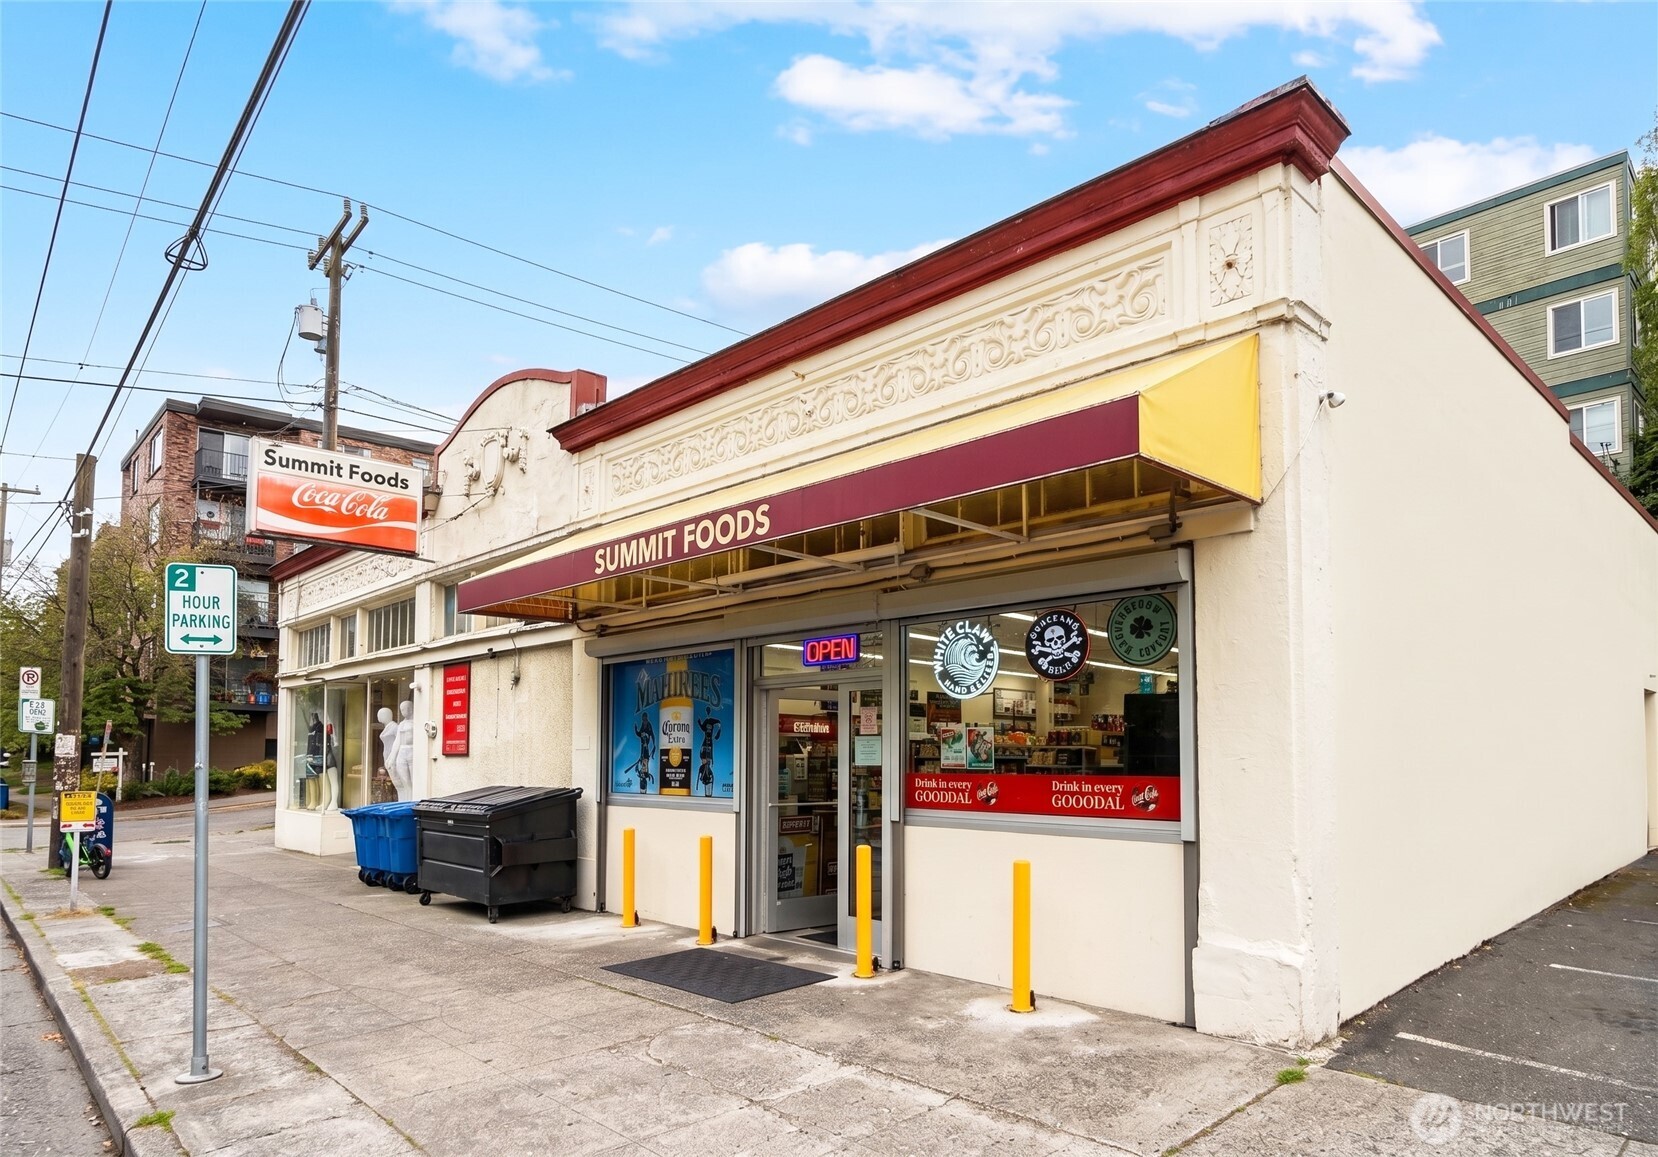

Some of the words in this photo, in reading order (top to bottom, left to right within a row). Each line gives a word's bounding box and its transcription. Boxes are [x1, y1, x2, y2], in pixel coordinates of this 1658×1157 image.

[264, 448, 343, 478] Summit
[349, 463, 409, 490] Foods
[594, 528, 677, 575] SUMMIT
[683, 503, 771, 554] FOODS
[174, 568, 189, 587] 2
[182, 595, 220, 610] HOUR
[172, 613, 231, 630] PARKING
[806, 637, 854, 662] OPEN
[933, 627, 956, 674] WHITE
[955, 620, 993, 644] CLAW
[944, 679, 968, 694] HAND
[662, 719, 690, 736] Corona
[915, 777, 938, 788] Drink
[939, 778, 947, 789] in
[948, 781, 973, 792] every
[1052, 780, 1080, 792] Drink
[1081, 781, 1092, 792] in
[1094, 784, 1124, 796] every
